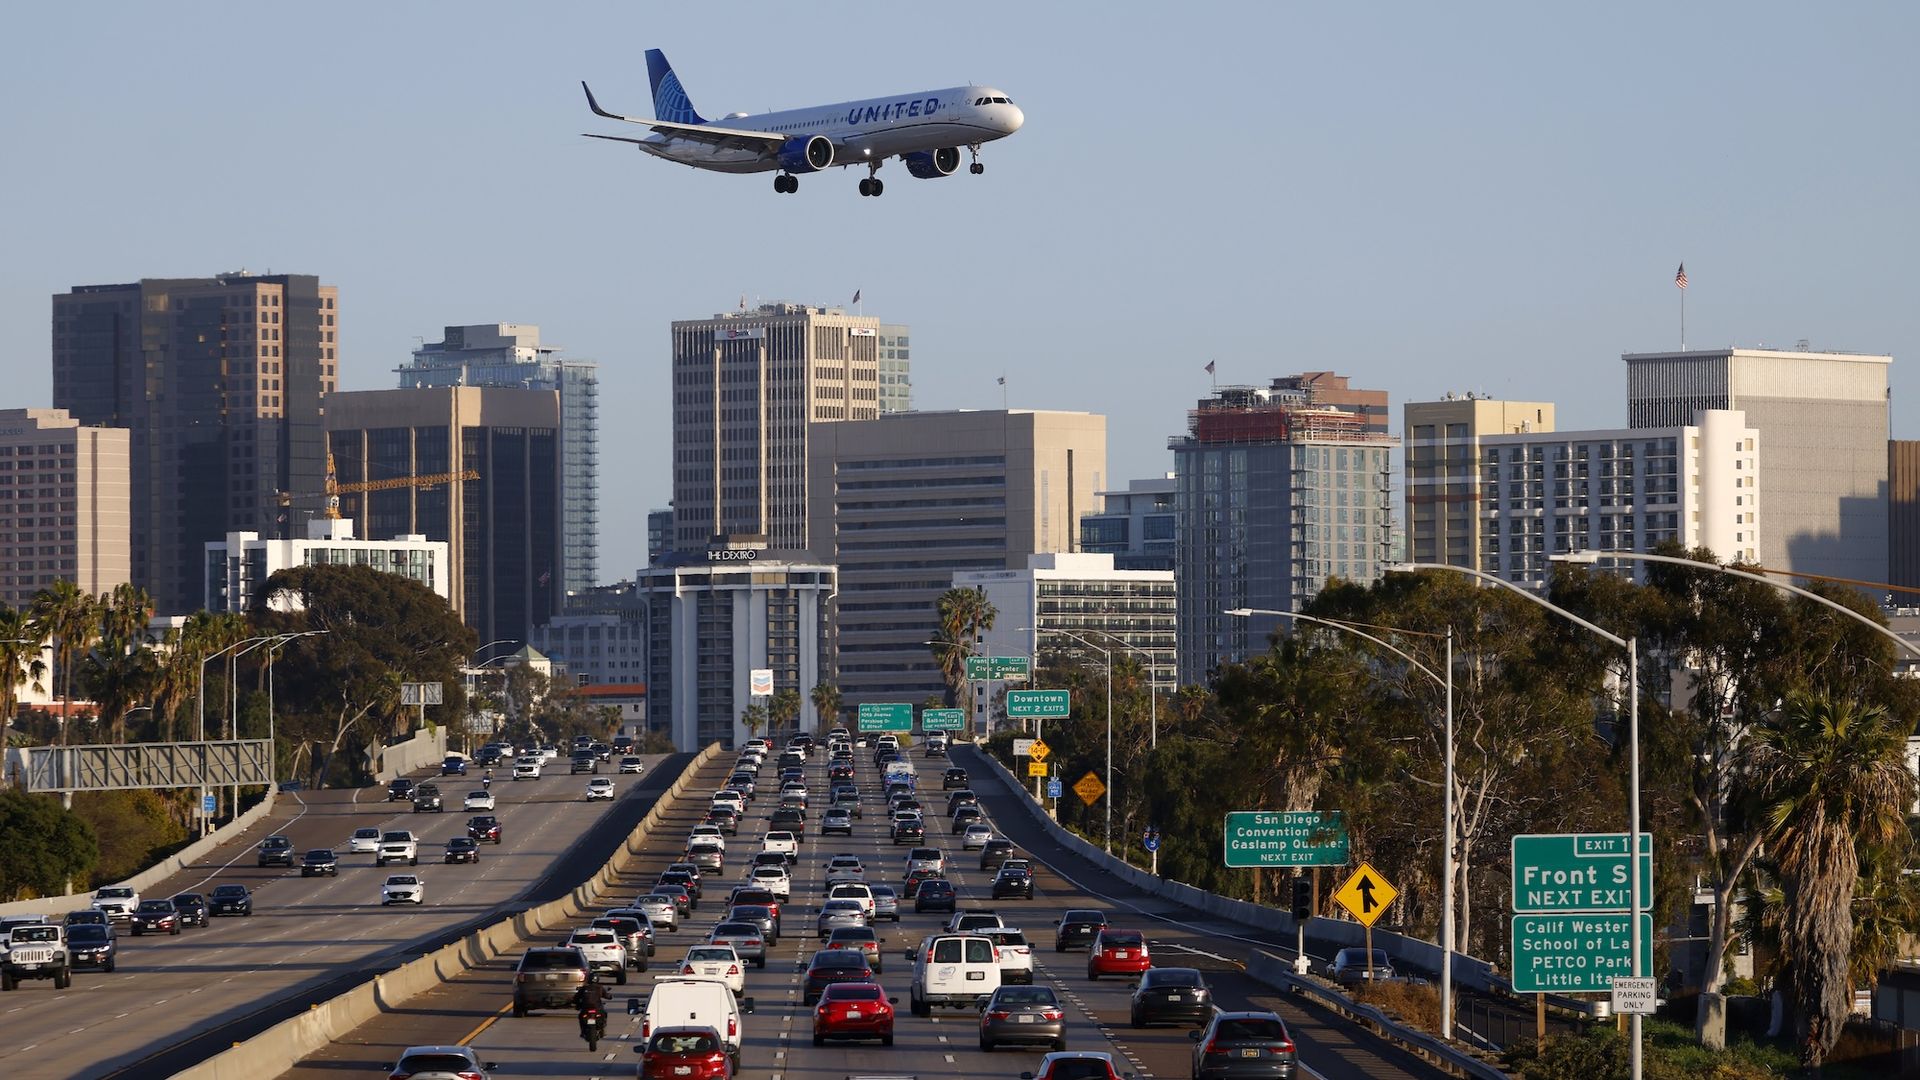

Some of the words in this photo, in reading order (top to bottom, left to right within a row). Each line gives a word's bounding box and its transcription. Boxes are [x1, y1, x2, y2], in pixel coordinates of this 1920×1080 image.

[848, 98, 939, 125] UNITED
[708, 551, 721, 560] THE
[722, 550, 756, 560] DEXTRO
[1013, 694, 1064, 703] Downtown
[1012, 705, 1031, 713] NEXT
[1034, 705, 1041, 713] 2
[1043, 704, 1065, 712] EXITS
[1255, 815, 1278, 825] San
[1283, 815, 1320, 826] Diego
[1237, 827, 1310, 838] Convention
[1231, 840, 1287, 851] Gaslamp
[1585, 840, 1615, 850] EXIT
[1260, 853, 1287, 862] NEXT
[1291, 853, 1314, 861] EXIT
[1523, 866, 1598, 886] Front
[1612, 864, 1630, 884] S
[1528, 890, 1583, 906] NEXT
[1525, 921, 1565, 934] Calif
[1572, 920, 1630, 934] Wester
[1522, 938, 1578, 951] School
[1586, 938, 1603, 951] of
[1533, 956, 1587, 969] PETCO
[1594, 955, 1632, 968] Park
[1535, 973, 1583, 986] Little
[1614, 981, 1654, 990] EMERGENCY
[1617, 991, 1651, 999] PARKING
[1623, 1001, 1645, 1009] ONLY
